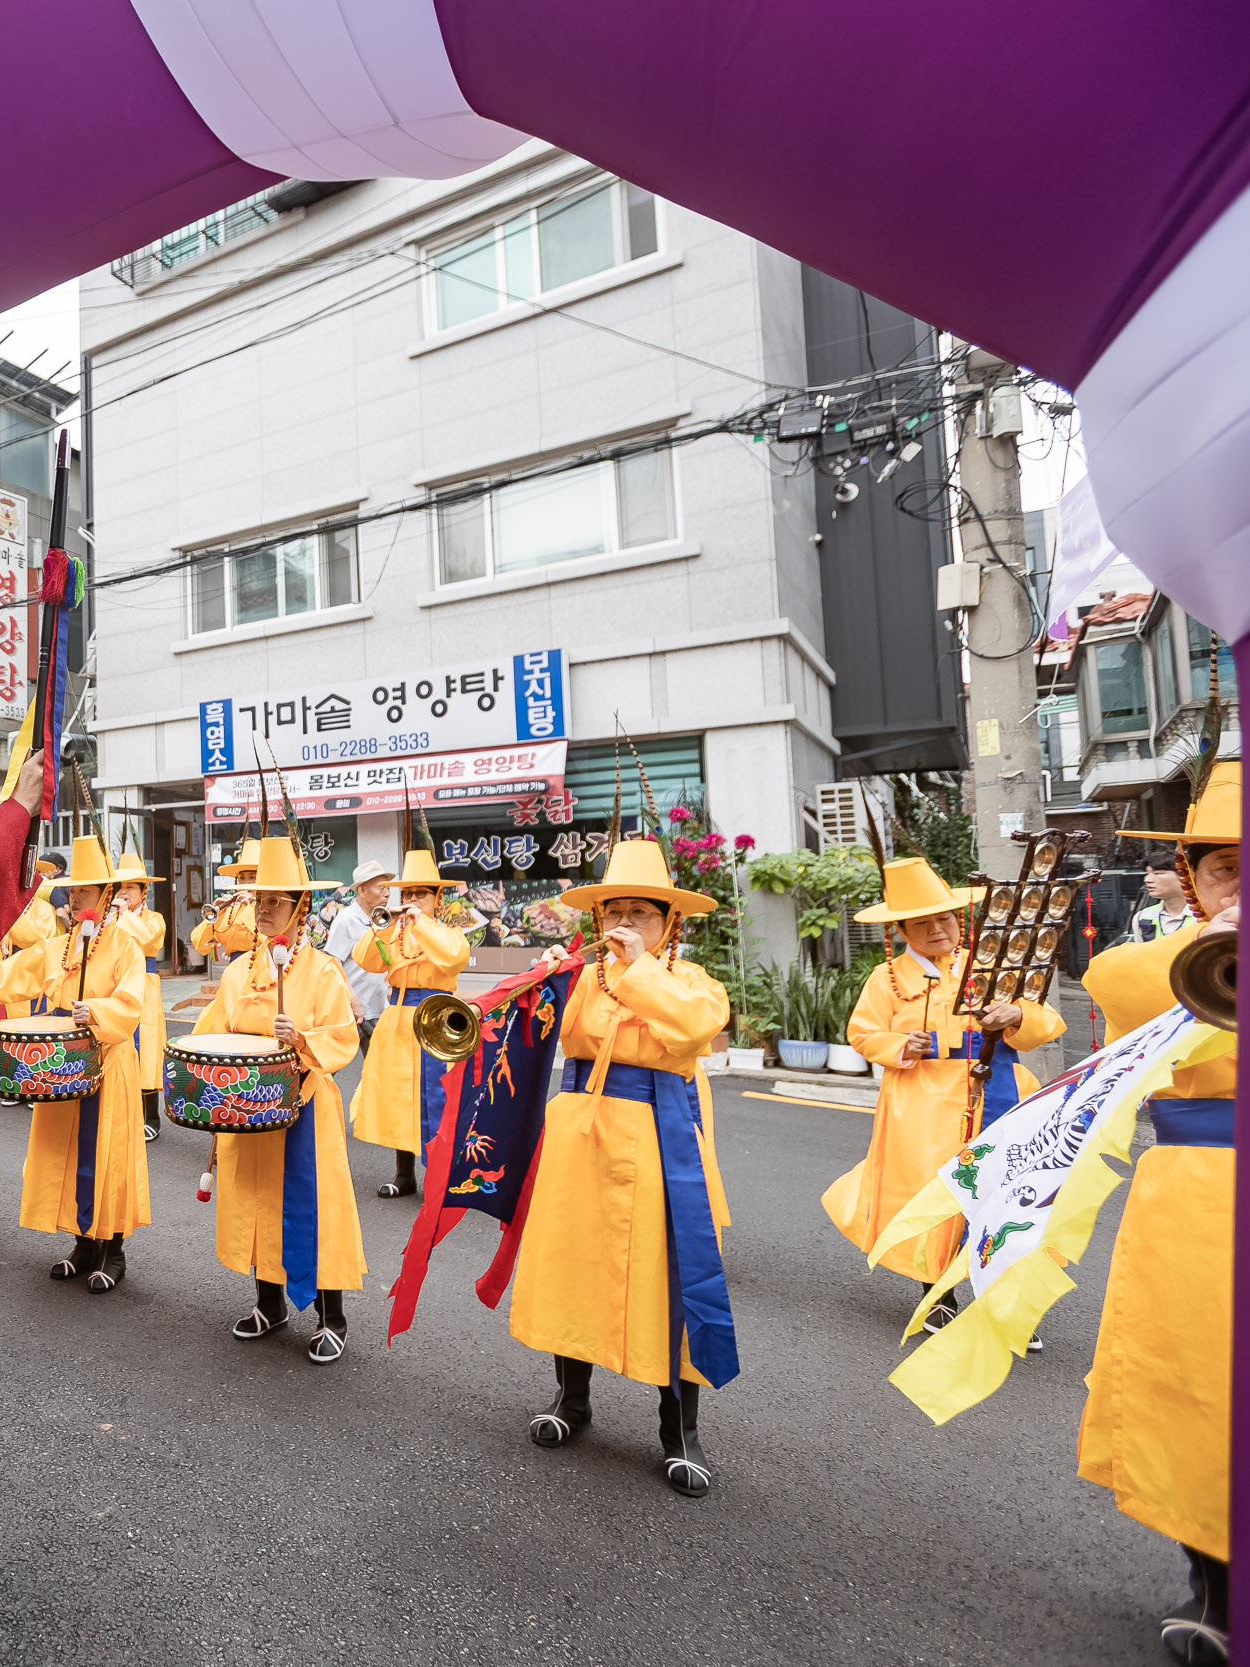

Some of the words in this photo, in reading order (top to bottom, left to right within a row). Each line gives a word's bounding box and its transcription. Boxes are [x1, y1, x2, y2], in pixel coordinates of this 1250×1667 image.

[239, 693, 353, 740] 가마솥
[372, 668, 505, 724] 영양탕
[522, 651, 557, 737] 보신탕
[205, 702, 228, 772] 흑염소
[302, 731, 430, 761] 010-2288-3533
[308, 770, 360, 791] 몸보신
[366, 766, 403, 787] 맛집
[408, 760, 466, 781] 가마솥
[473, 752, 537, 775] 영양탕
[438, 831, 540, 871] 보신탕
